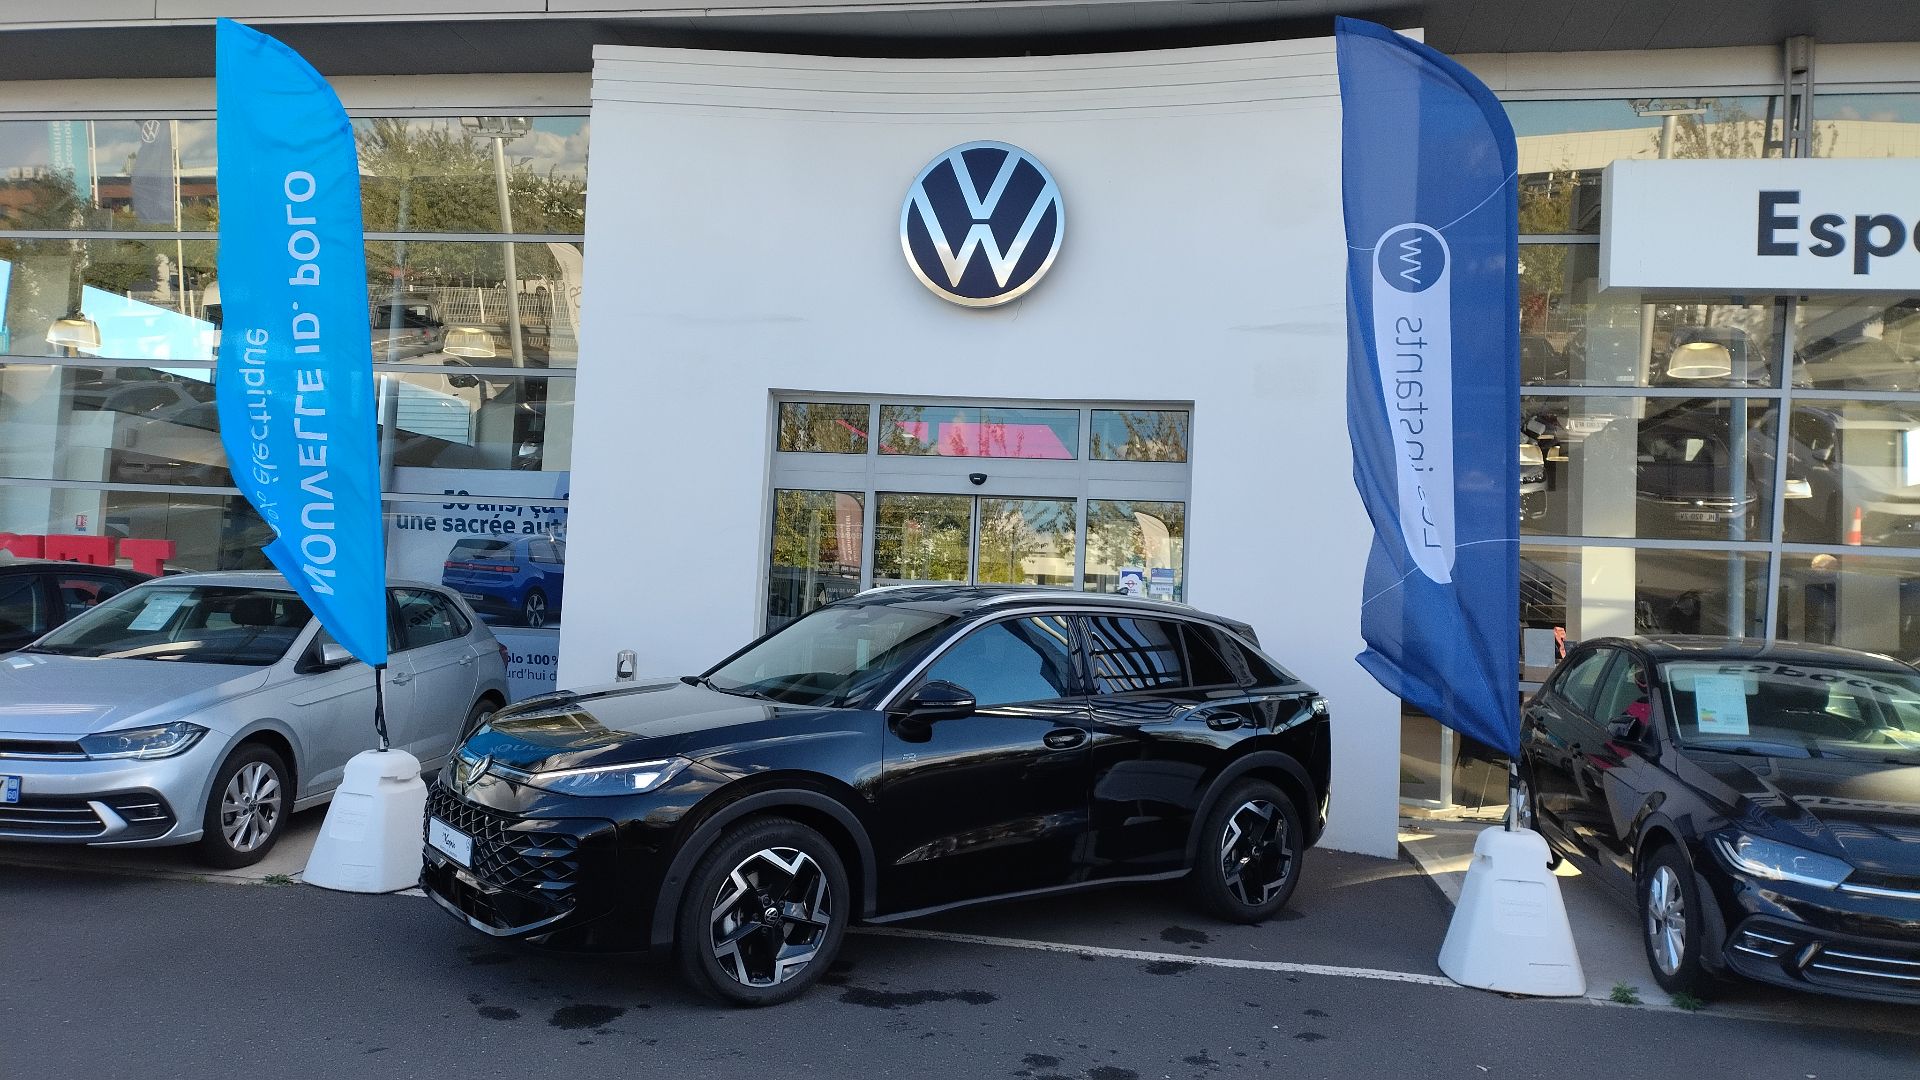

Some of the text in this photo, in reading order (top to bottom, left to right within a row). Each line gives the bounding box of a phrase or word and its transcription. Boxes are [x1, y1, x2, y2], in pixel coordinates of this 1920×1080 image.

[903, 142, 1063, 304] VW
[1756, 189, 1920, 276] Esp
[396, 513, 568, 537] une sacrée aut
[507, 652, 524, 664] olo
[526, 653, 550, 666] 100
[507, 668, 546, 681] urd'hui
